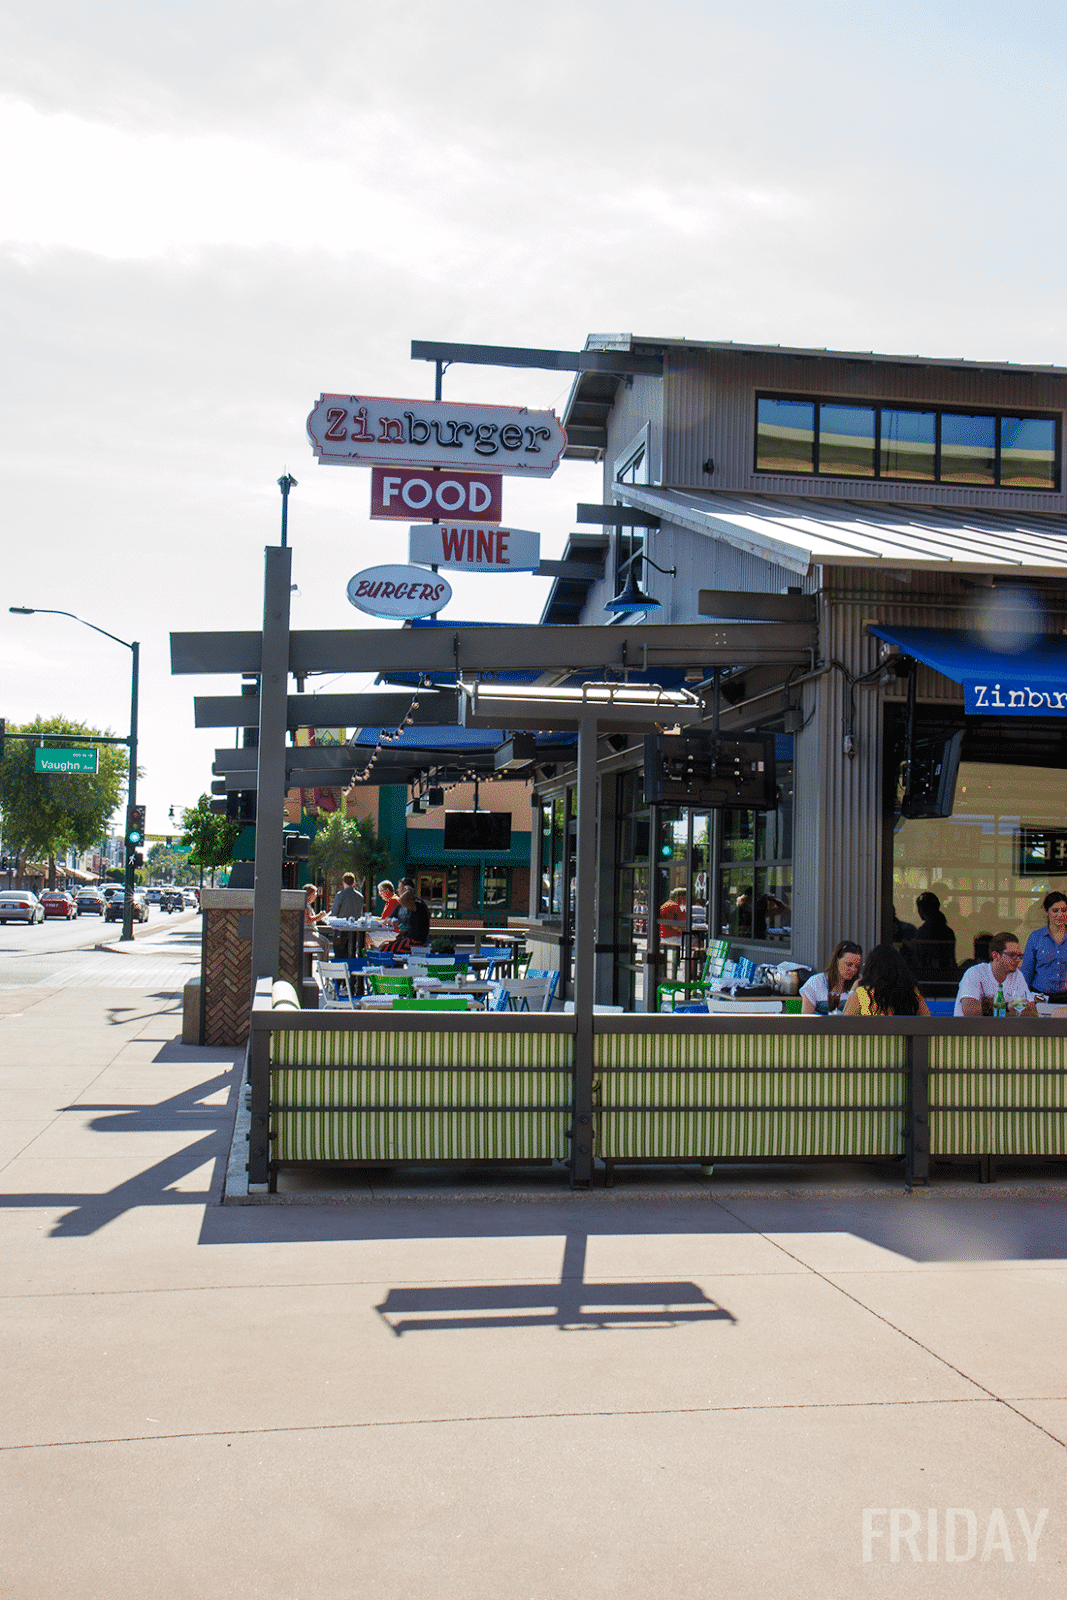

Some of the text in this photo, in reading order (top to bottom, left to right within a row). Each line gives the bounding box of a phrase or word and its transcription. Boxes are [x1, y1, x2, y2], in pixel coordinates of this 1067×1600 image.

[325, 407, 550, 456] Zinburger
[382, 476, 492, 513] FOOD
[441, 527, 511, 564] WINE
[355, 580, 445, 601] BURGERS
[974, 683, 1067, 709] Zinbur
[41, 760, 80, 771] Vaughn
